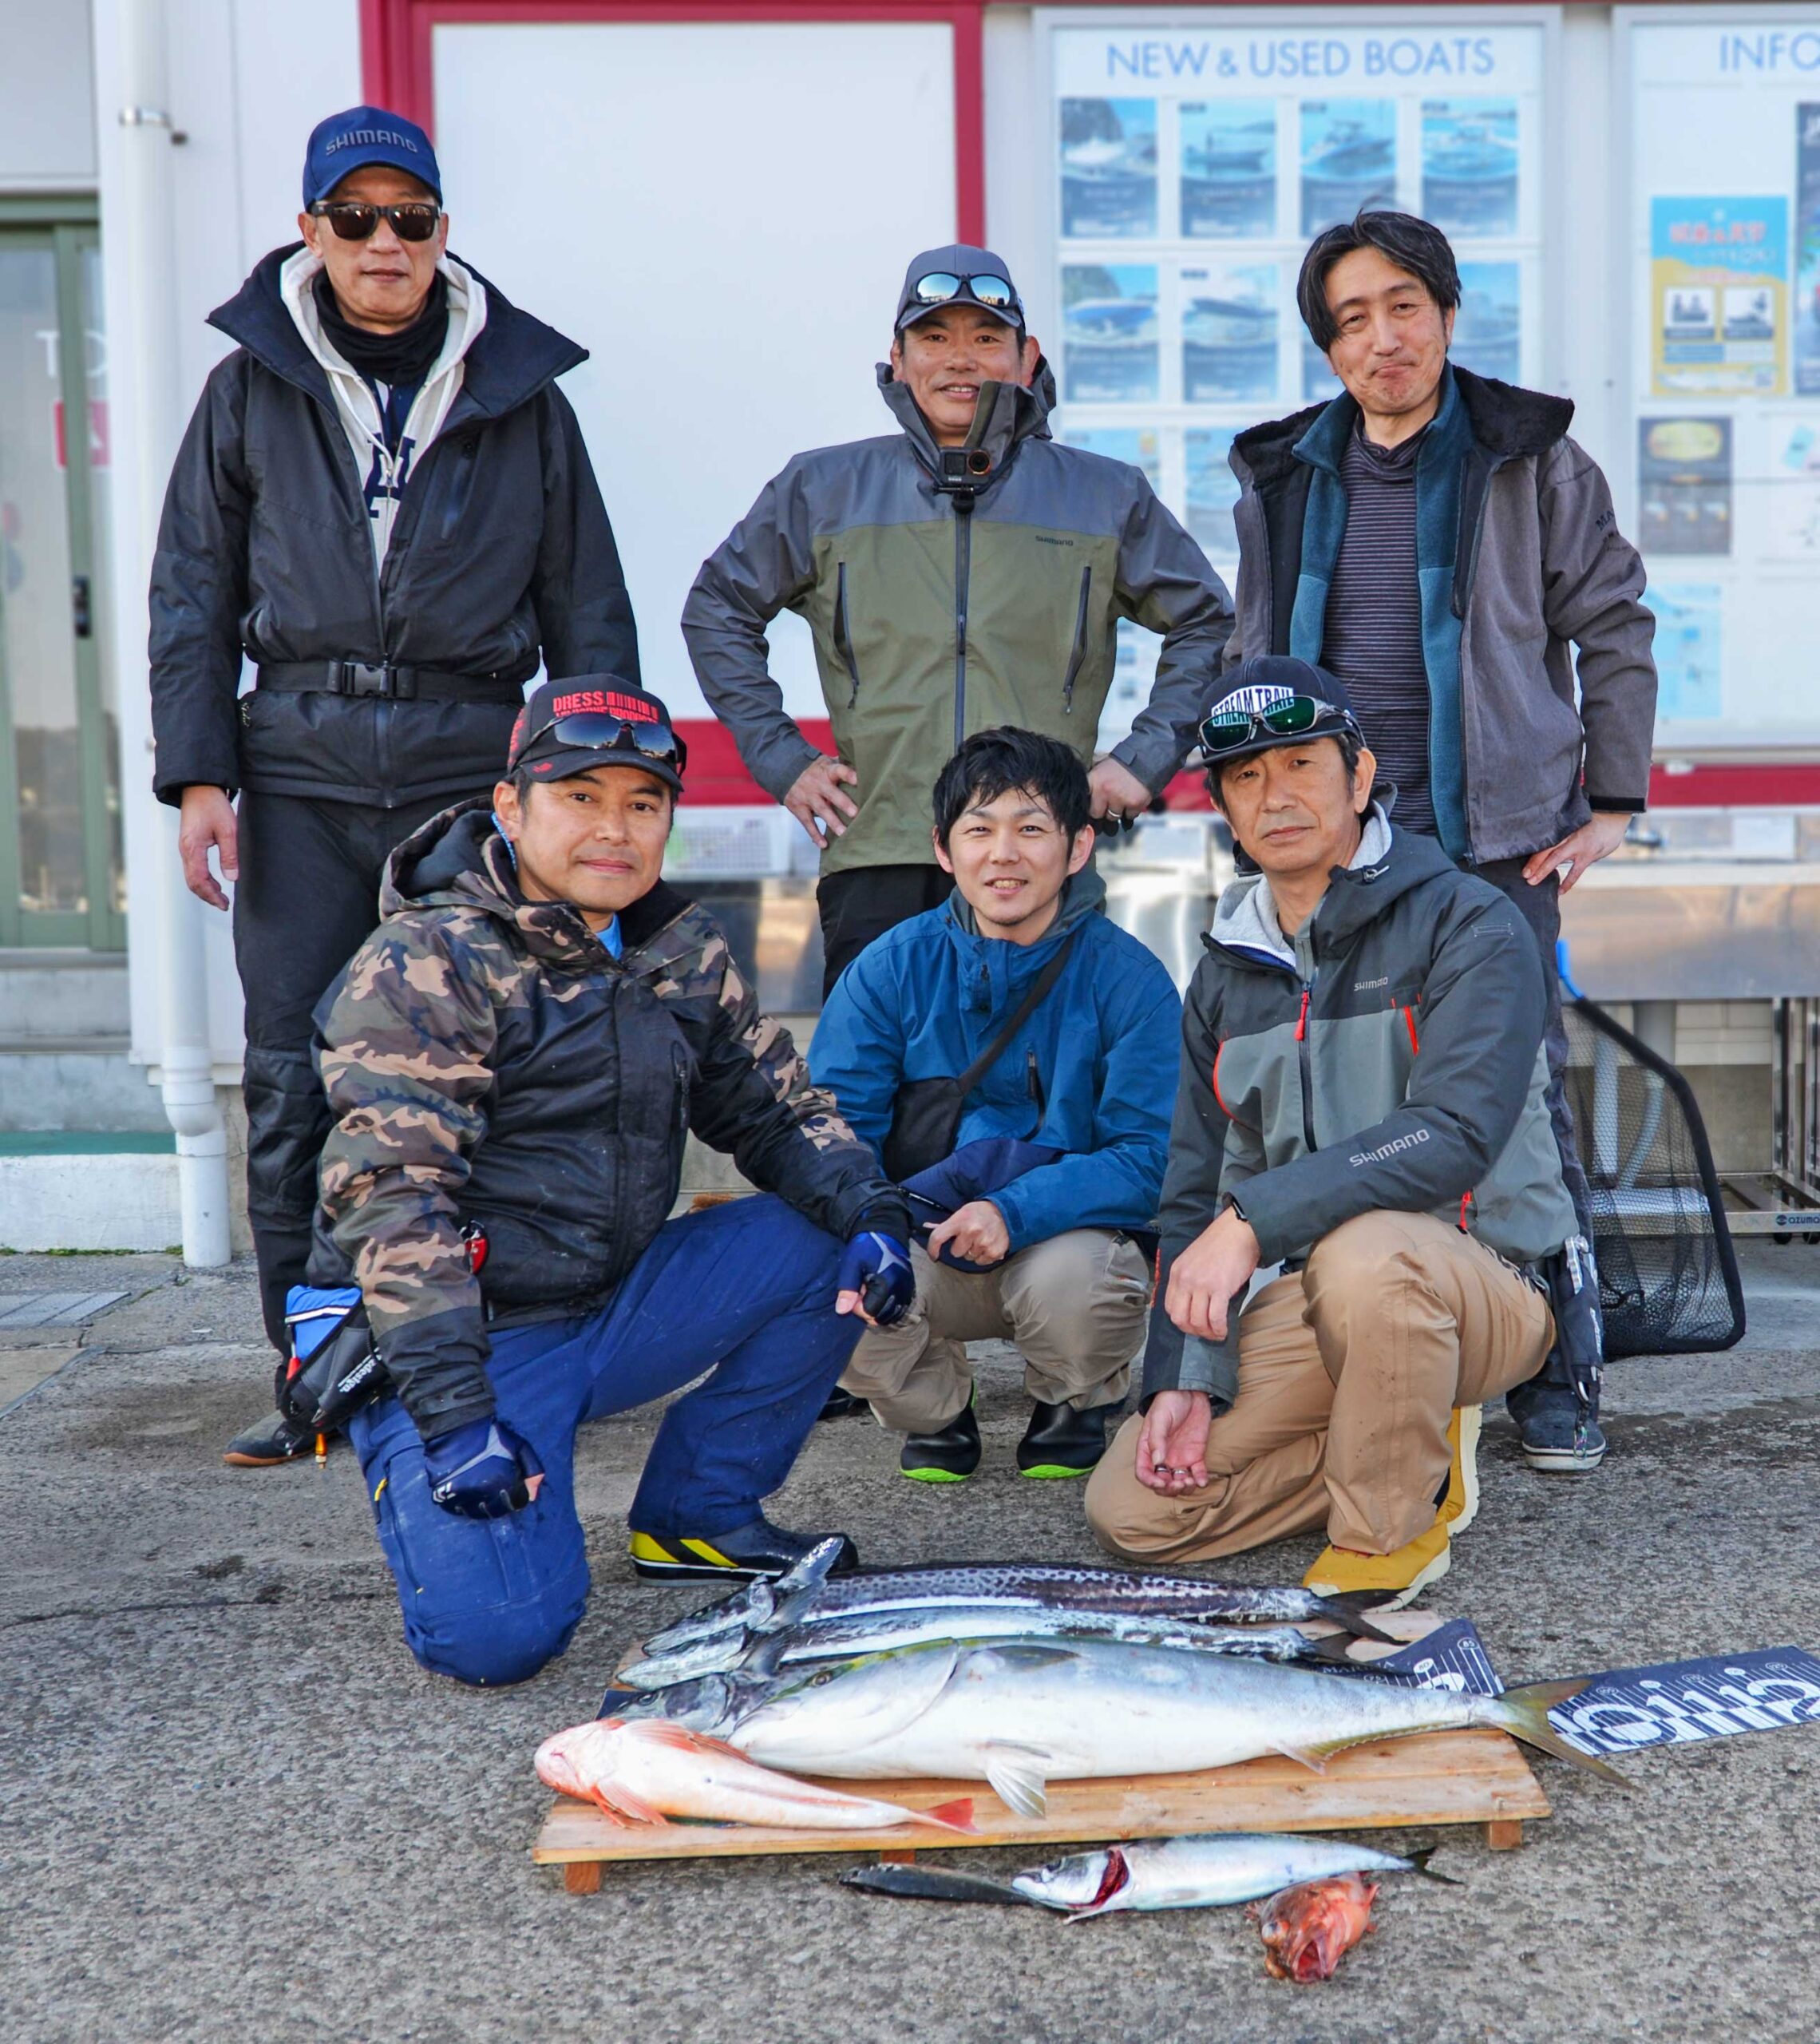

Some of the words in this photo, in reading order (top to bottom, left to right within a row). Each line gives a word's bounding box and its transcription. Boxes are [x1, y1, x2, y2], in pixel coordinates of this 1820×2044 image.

[1106, 41, 1210, 78] NEW
[1217, 47, 1239, 77] &
[1248, 39, 1351, 78] USED
[1364, 38, 1495, 77] BOATS
[1719, 32, 1820, 71] INFO
[326, 129, 418, 156] SHIMANO
[552, 691, 604, 712] DRESS
[1213, 688, 1254, 723] STREAM
[1349, 1129, 1430, 1167] SHIMANO
